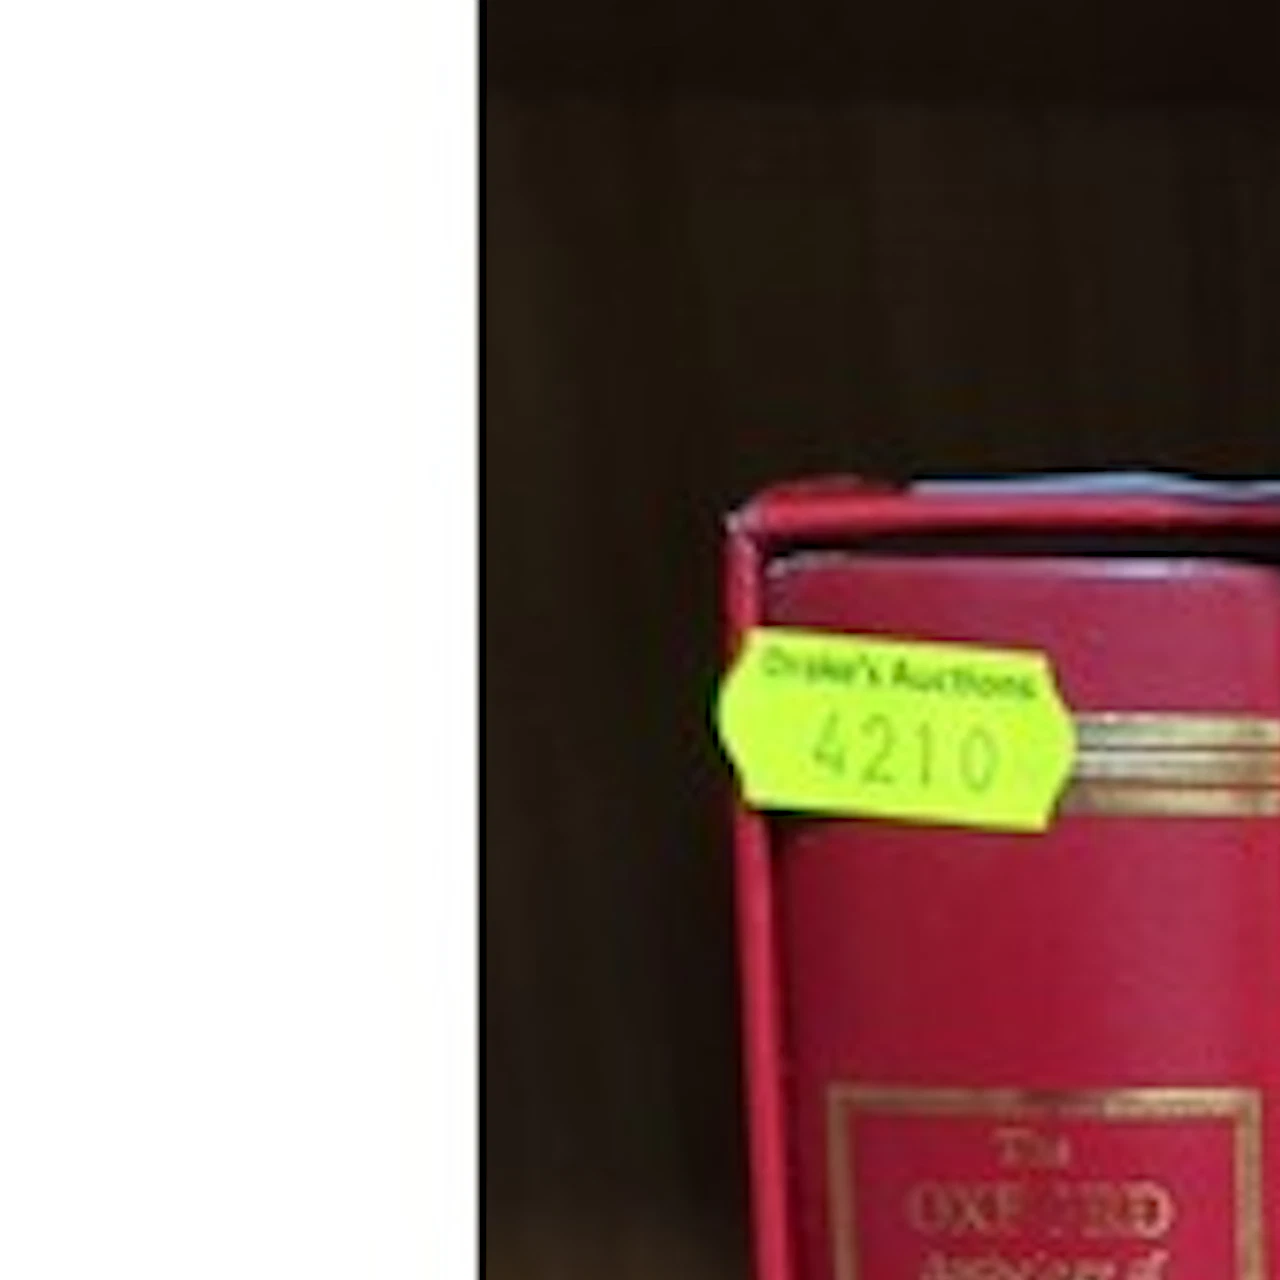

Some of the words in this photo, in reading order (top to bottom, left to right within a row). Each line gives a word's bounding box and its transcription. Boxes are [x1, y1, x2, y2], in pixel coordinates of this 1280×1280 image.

[891, 657, 1038, 699] Auctions
[812, 710, 999, 793] 4210
[904, 1179, 1176, 1238] OXFRD
